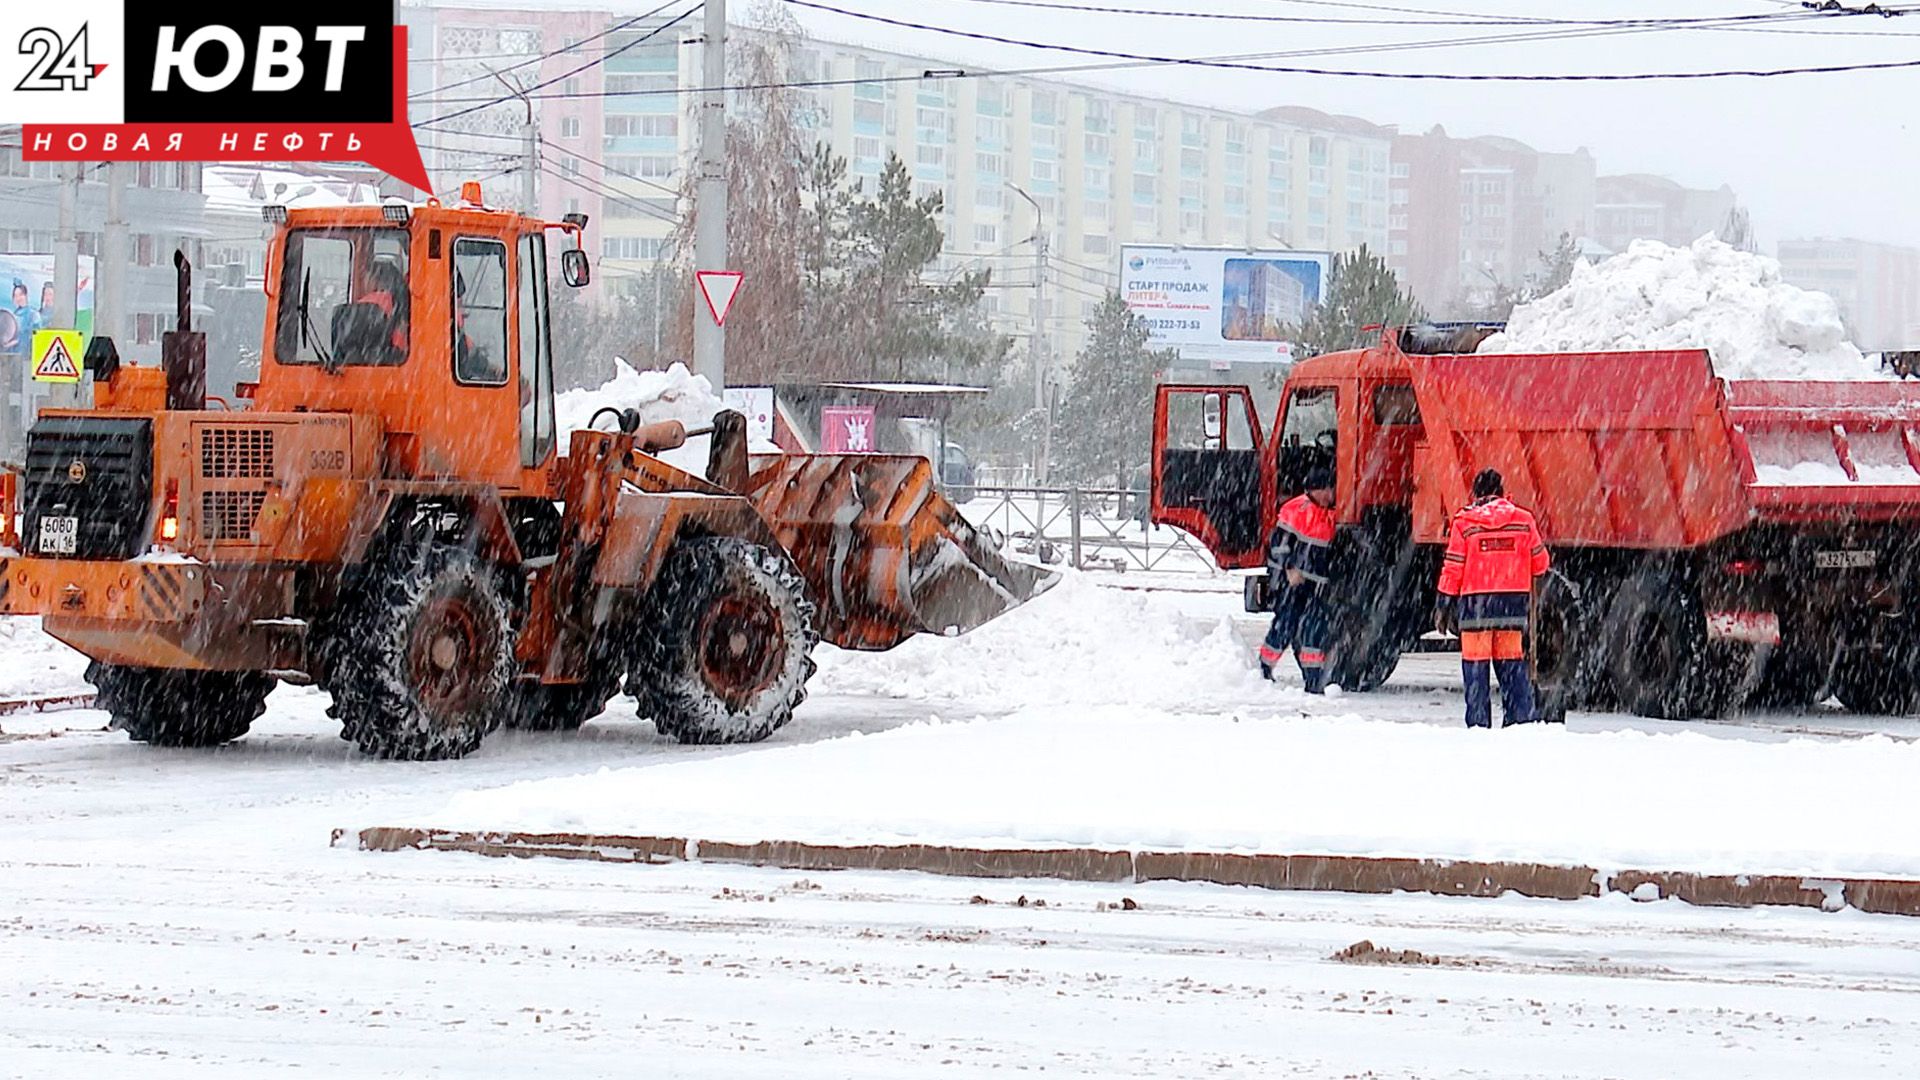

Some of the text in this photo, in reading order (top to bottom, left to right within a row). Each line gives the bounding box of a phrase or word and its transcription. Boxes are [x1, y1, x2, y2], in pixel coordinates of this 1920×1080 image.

[1128, 281, 1209, 293] СТАРТ ПРОДАЖ
[1127, 291, 1160, 300] ЛИТЕР
[45, 518, 73, 533] 6080
